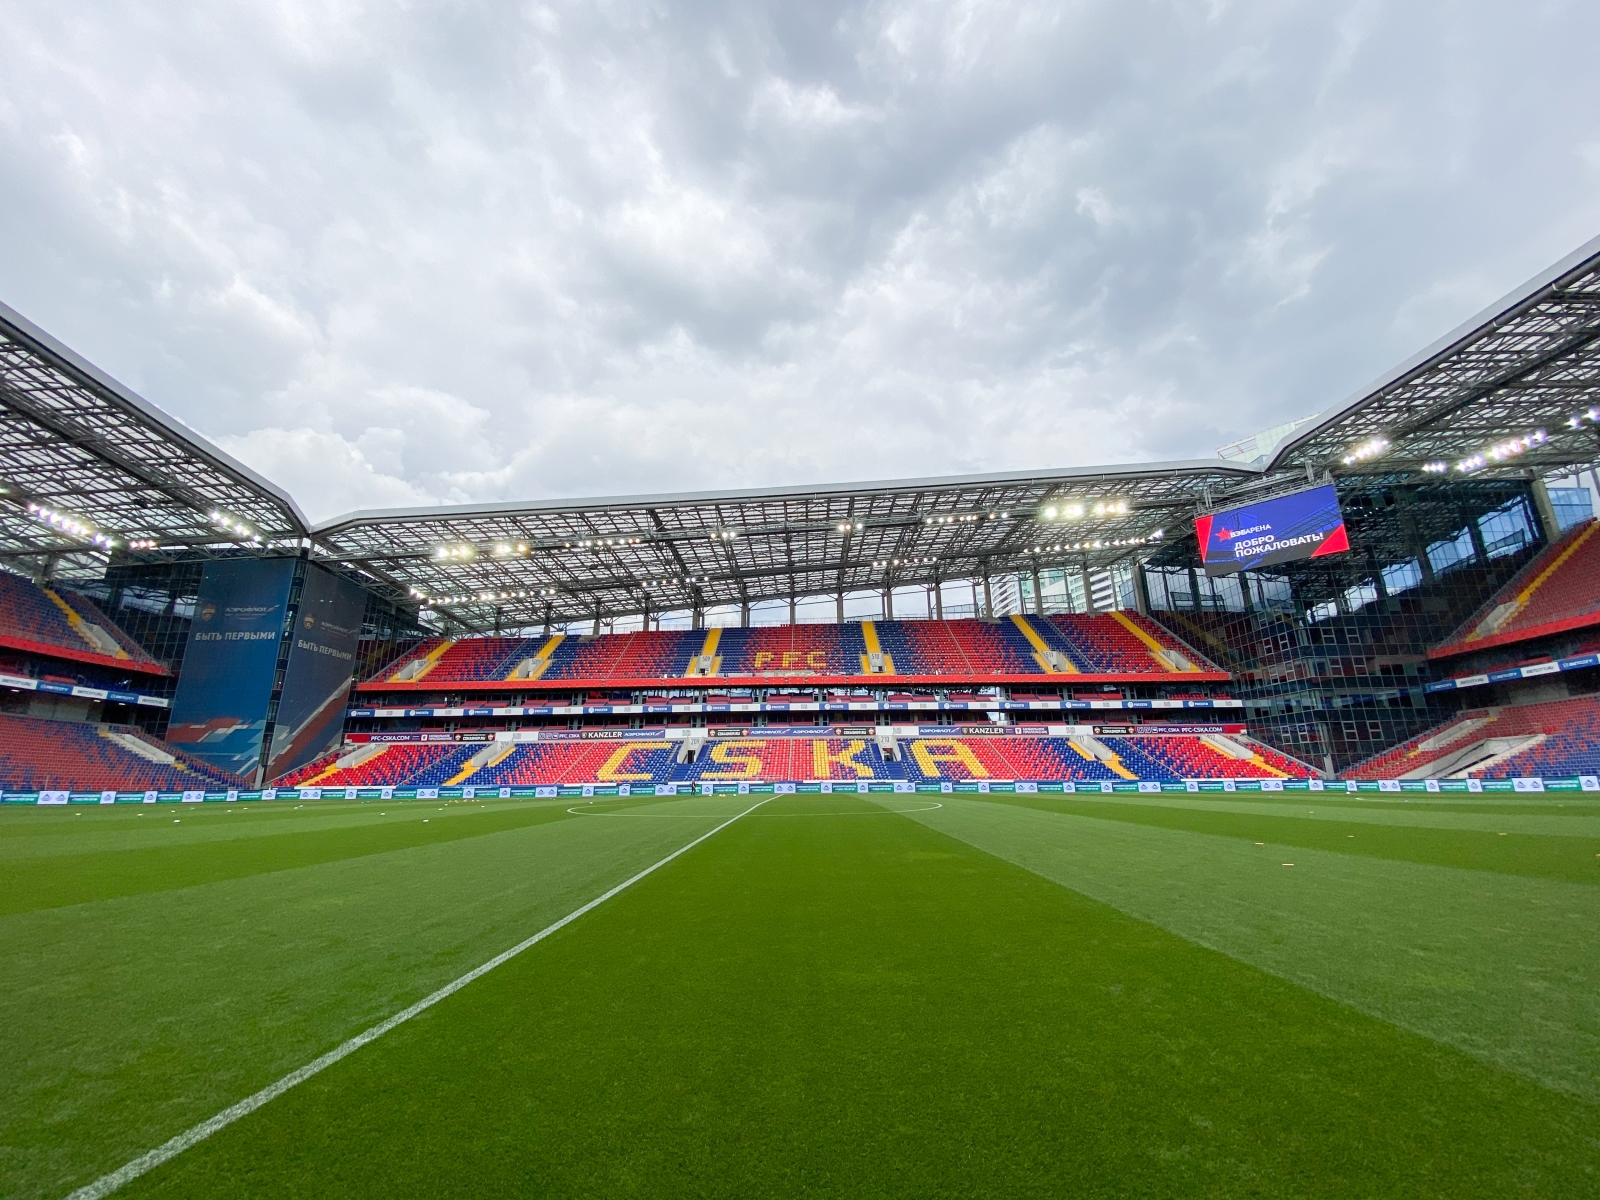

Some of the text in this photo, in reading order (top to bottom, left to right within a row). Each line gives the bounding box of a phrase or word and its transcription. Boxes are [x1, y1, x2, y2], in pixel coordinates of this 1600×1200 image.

[1235, 535, 1274, 551] ДОБРО
[1235, 532, 1324, 557] ПОЖАЛОВАТЬ!
[225, 632, 275, 640] ПЕРВЫМИ
[298, 639, 352, 661] БЫТЬ ПЕРВЫМИ
[755, 651, 827, 668] PFC
